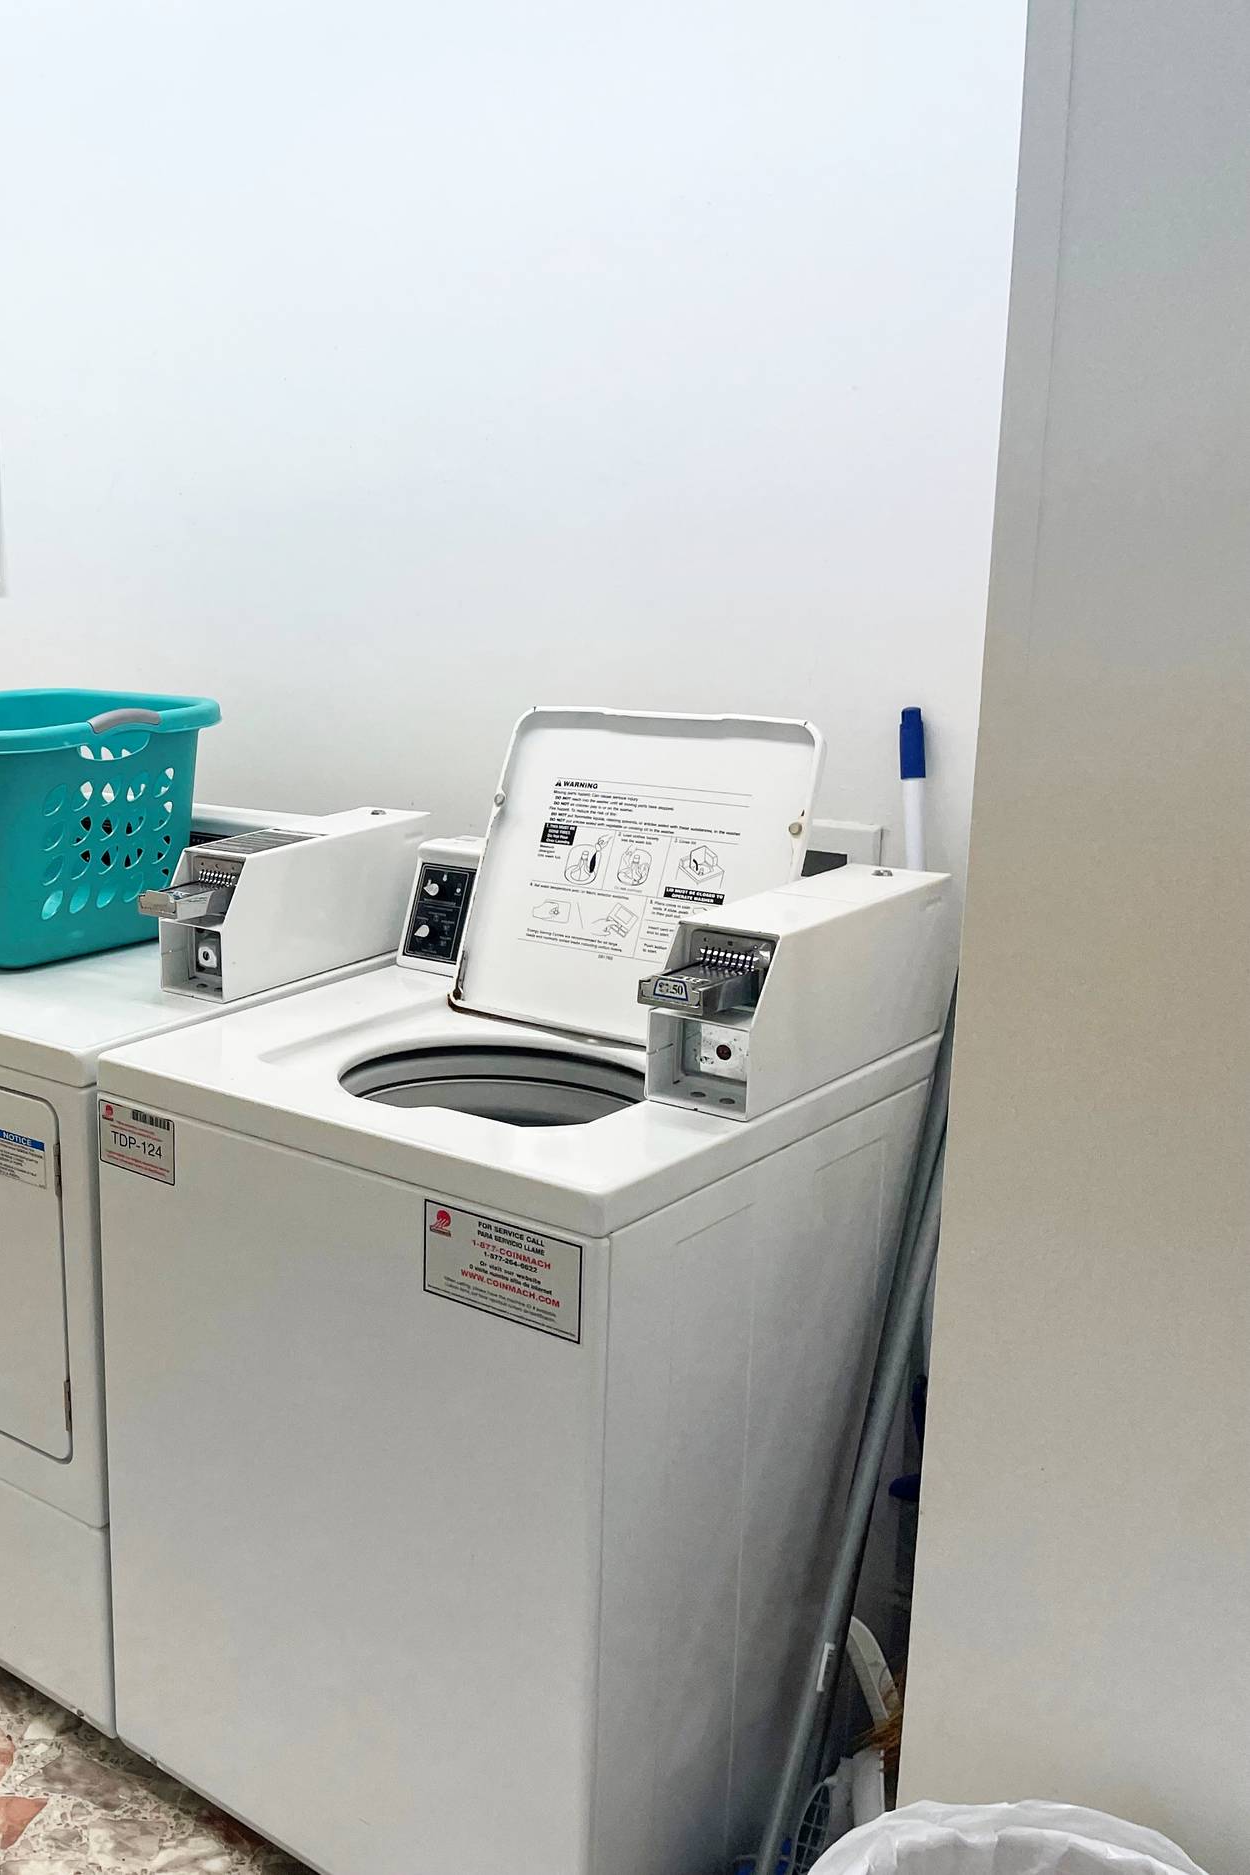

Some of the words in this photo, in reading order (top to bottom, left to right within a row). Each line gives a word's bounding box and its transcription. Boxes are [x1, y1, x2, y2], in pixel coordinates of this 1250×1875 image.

[563, 780, 598, 790] WARNING
[2, 1131, 32, 1146] NOTICE
[111, 1130, 162, 1159] TDP-124
[477, 1229, 493, 1240] PARA
[494, 1234, 523, 1249] SERVICIO
[524, 1243, 545, 1256] LLAME
[478, 1221, 492, 1231] FOR
[493, 1225, 525, 1241] SERVICE
[526, 1235, 545, 1247] CALL
[471, 1239, 551, 1270] 1-877-COINMACH
[489, 1262, 503, 1272] visit
[503, 1268, 514, 1277] our
[516, 1273, 542, 1285] website
[460, 1268, 560, 1308] WWW.COINMACH.COM
